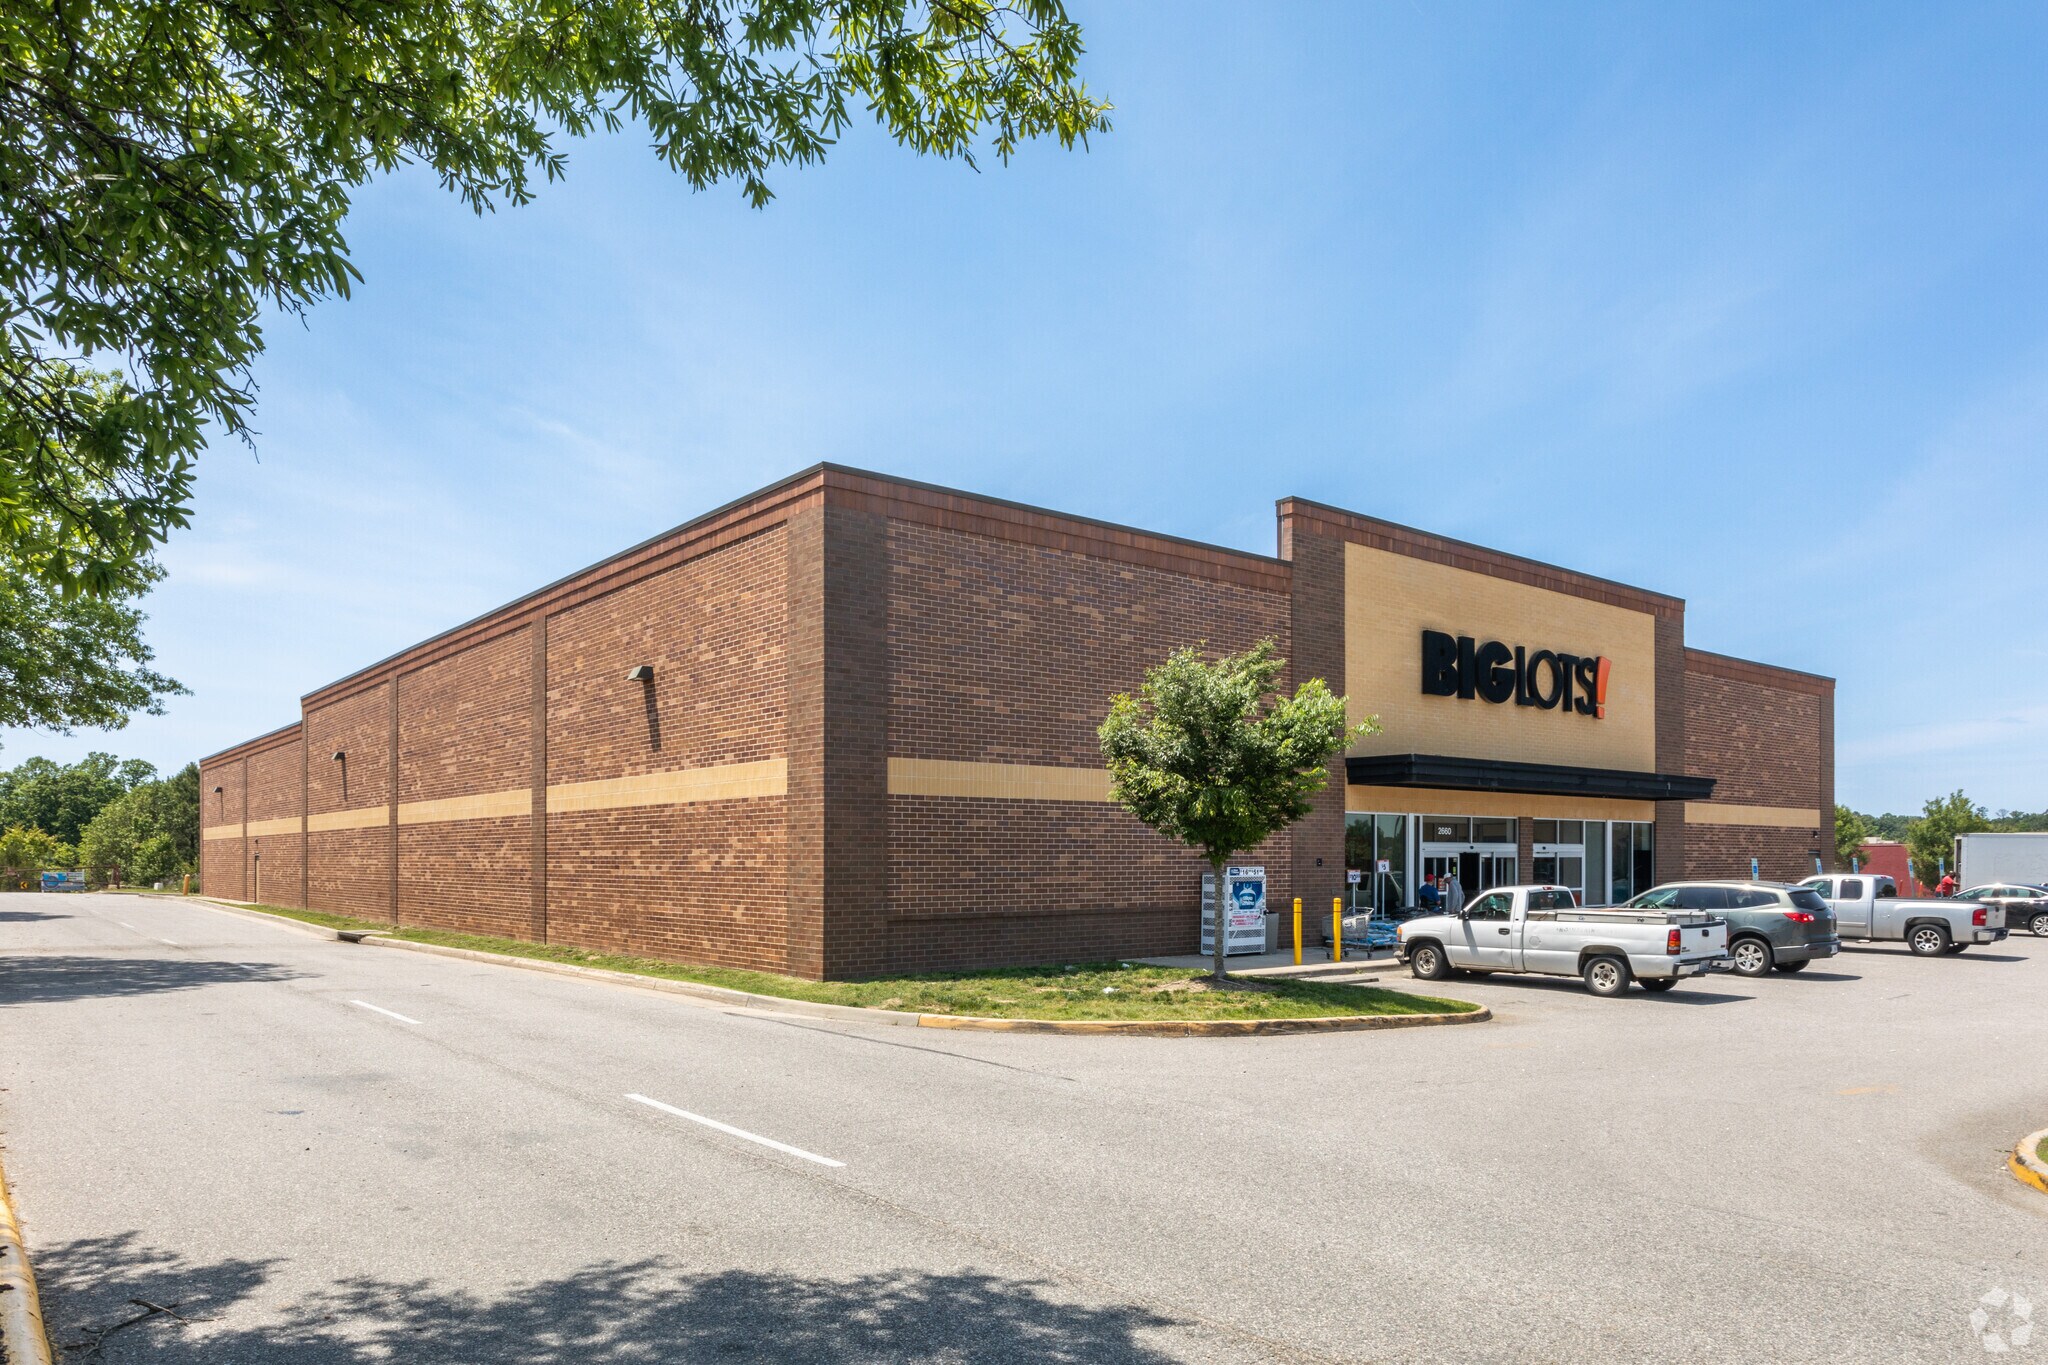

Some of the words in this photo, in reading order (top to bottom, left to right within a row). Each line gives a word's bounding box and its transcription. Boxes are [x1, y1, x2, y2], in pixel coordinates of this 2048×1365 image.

[1422, 629, 1515, 704] BIG
[1515, 646, 1612, 720] LOTS!
[1437, 826, 1452, 836] 2660
